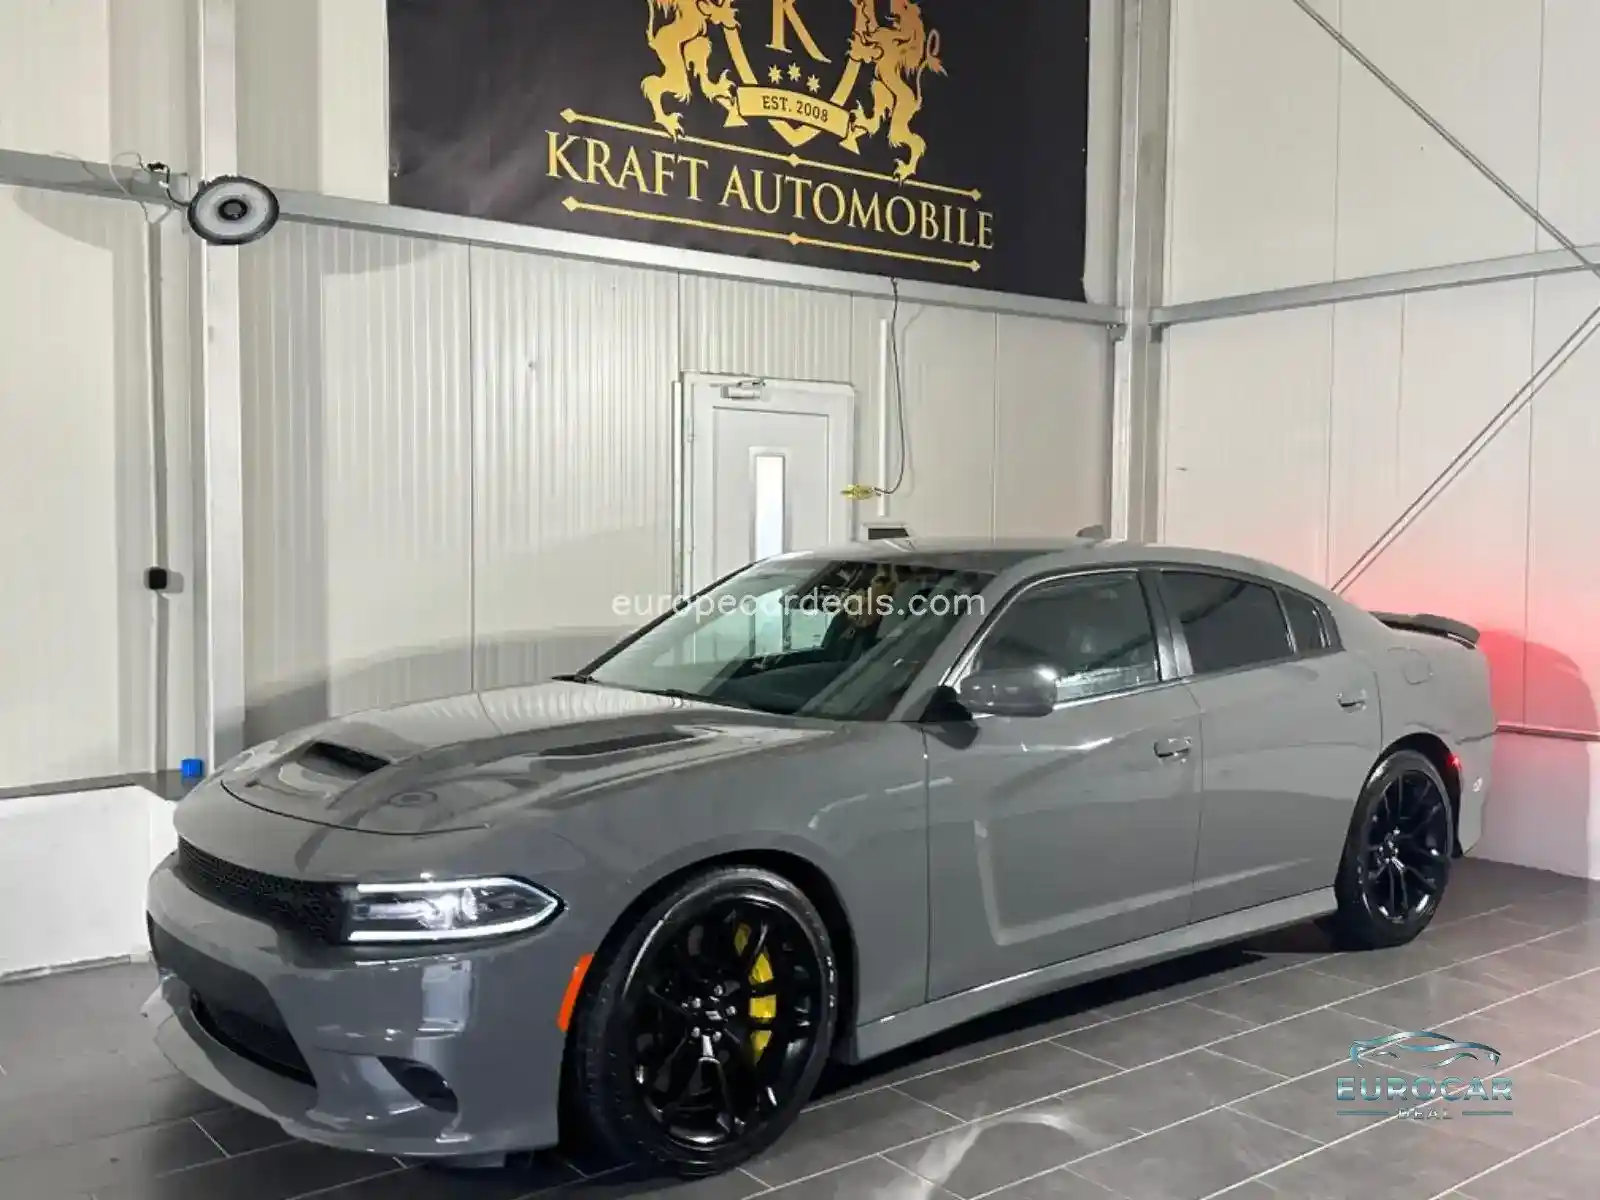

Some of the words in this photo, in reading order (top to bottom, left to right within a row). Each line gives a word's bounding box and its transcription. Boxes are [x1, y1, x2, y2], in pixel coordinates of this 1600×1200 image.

[762, 95, 793, 113] EST.
[796, 100, 829, 122] 2008
[545, 130, 709, 201] KRAFT
[718, 165, 994, 249] AUTOMOBILE
